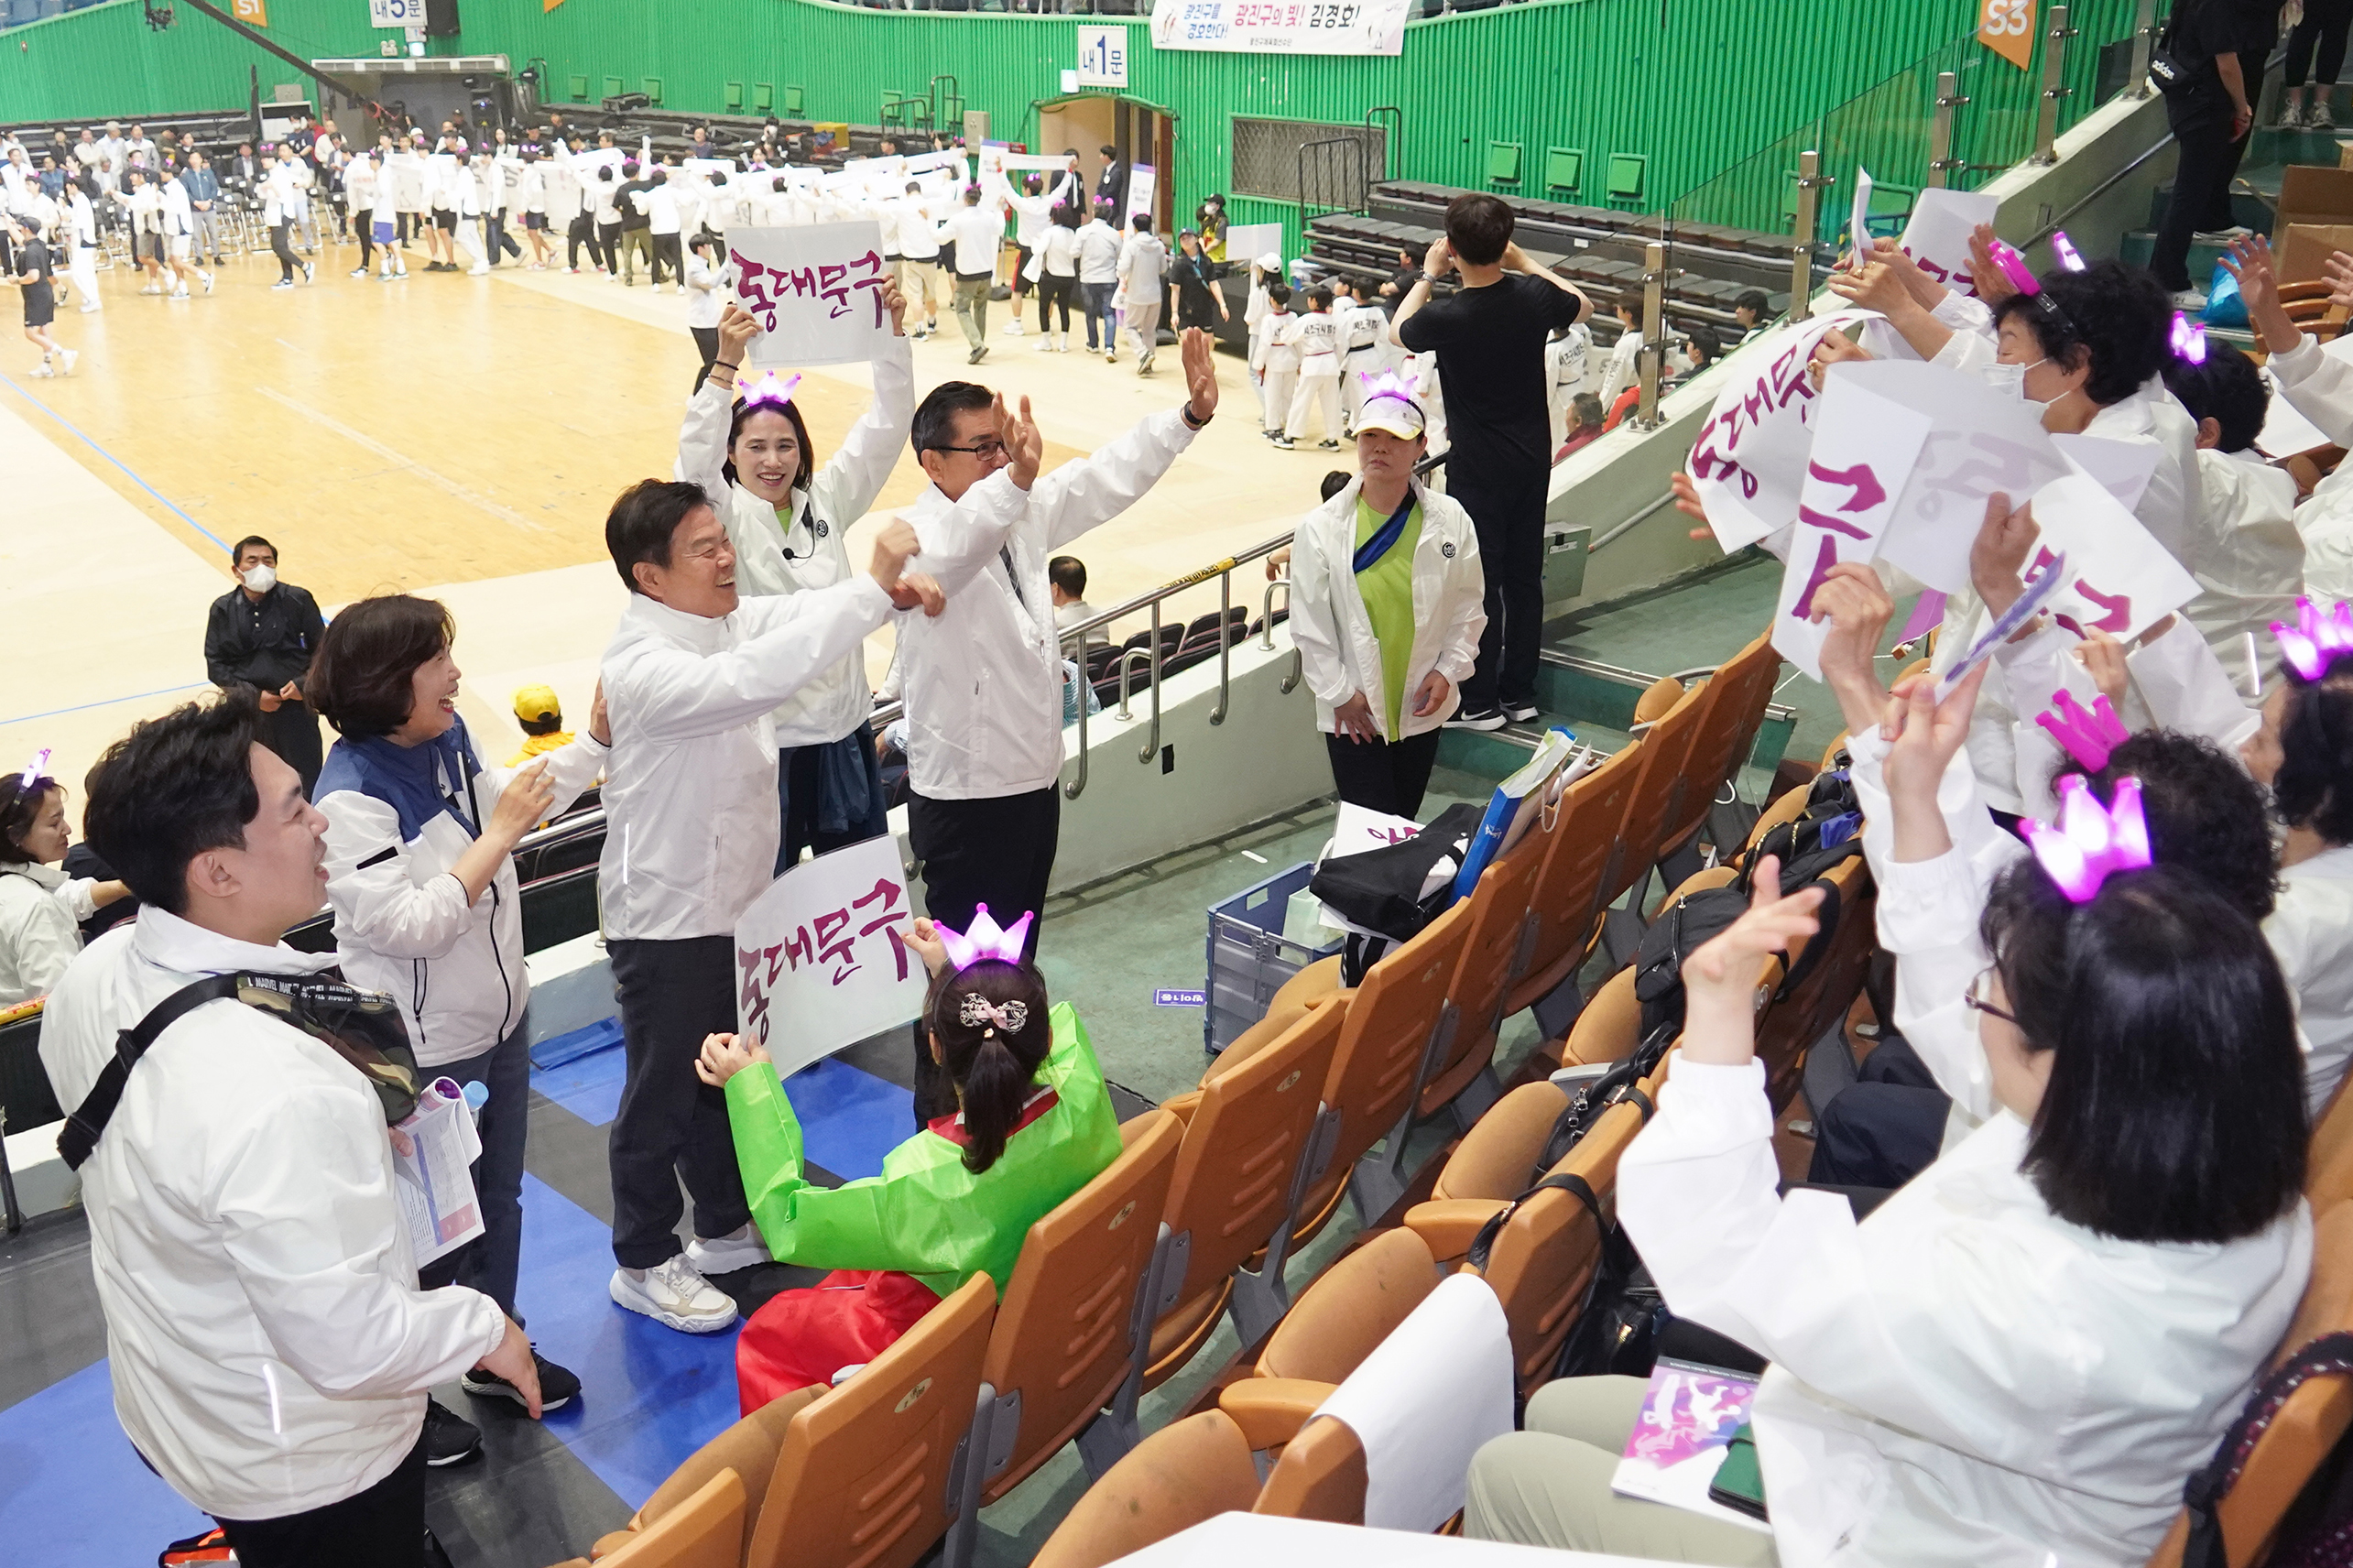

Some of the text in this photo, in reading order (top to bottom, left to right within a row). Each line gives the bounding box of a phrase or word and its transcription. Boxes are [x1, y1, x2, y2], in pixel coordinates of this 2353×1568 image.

[238, 0, 260, 16] S1
[1183, 3, 1222, 19] 광진구를
[1235, 4, 1361, 28] 광진구의 빛! 김경호!
[1985, 0, 2028, 36] S3
[1187, 23, 1229, 39] 경호한다!
[1083, 34, 1123, 78] 내1문
[2151, 59, 2175, 81] adidas
[730, 247, 886, 333] 동대문구
[737, 877, 909, 1046] 동대문구
[255, 976, 278, 992] MARVEL
